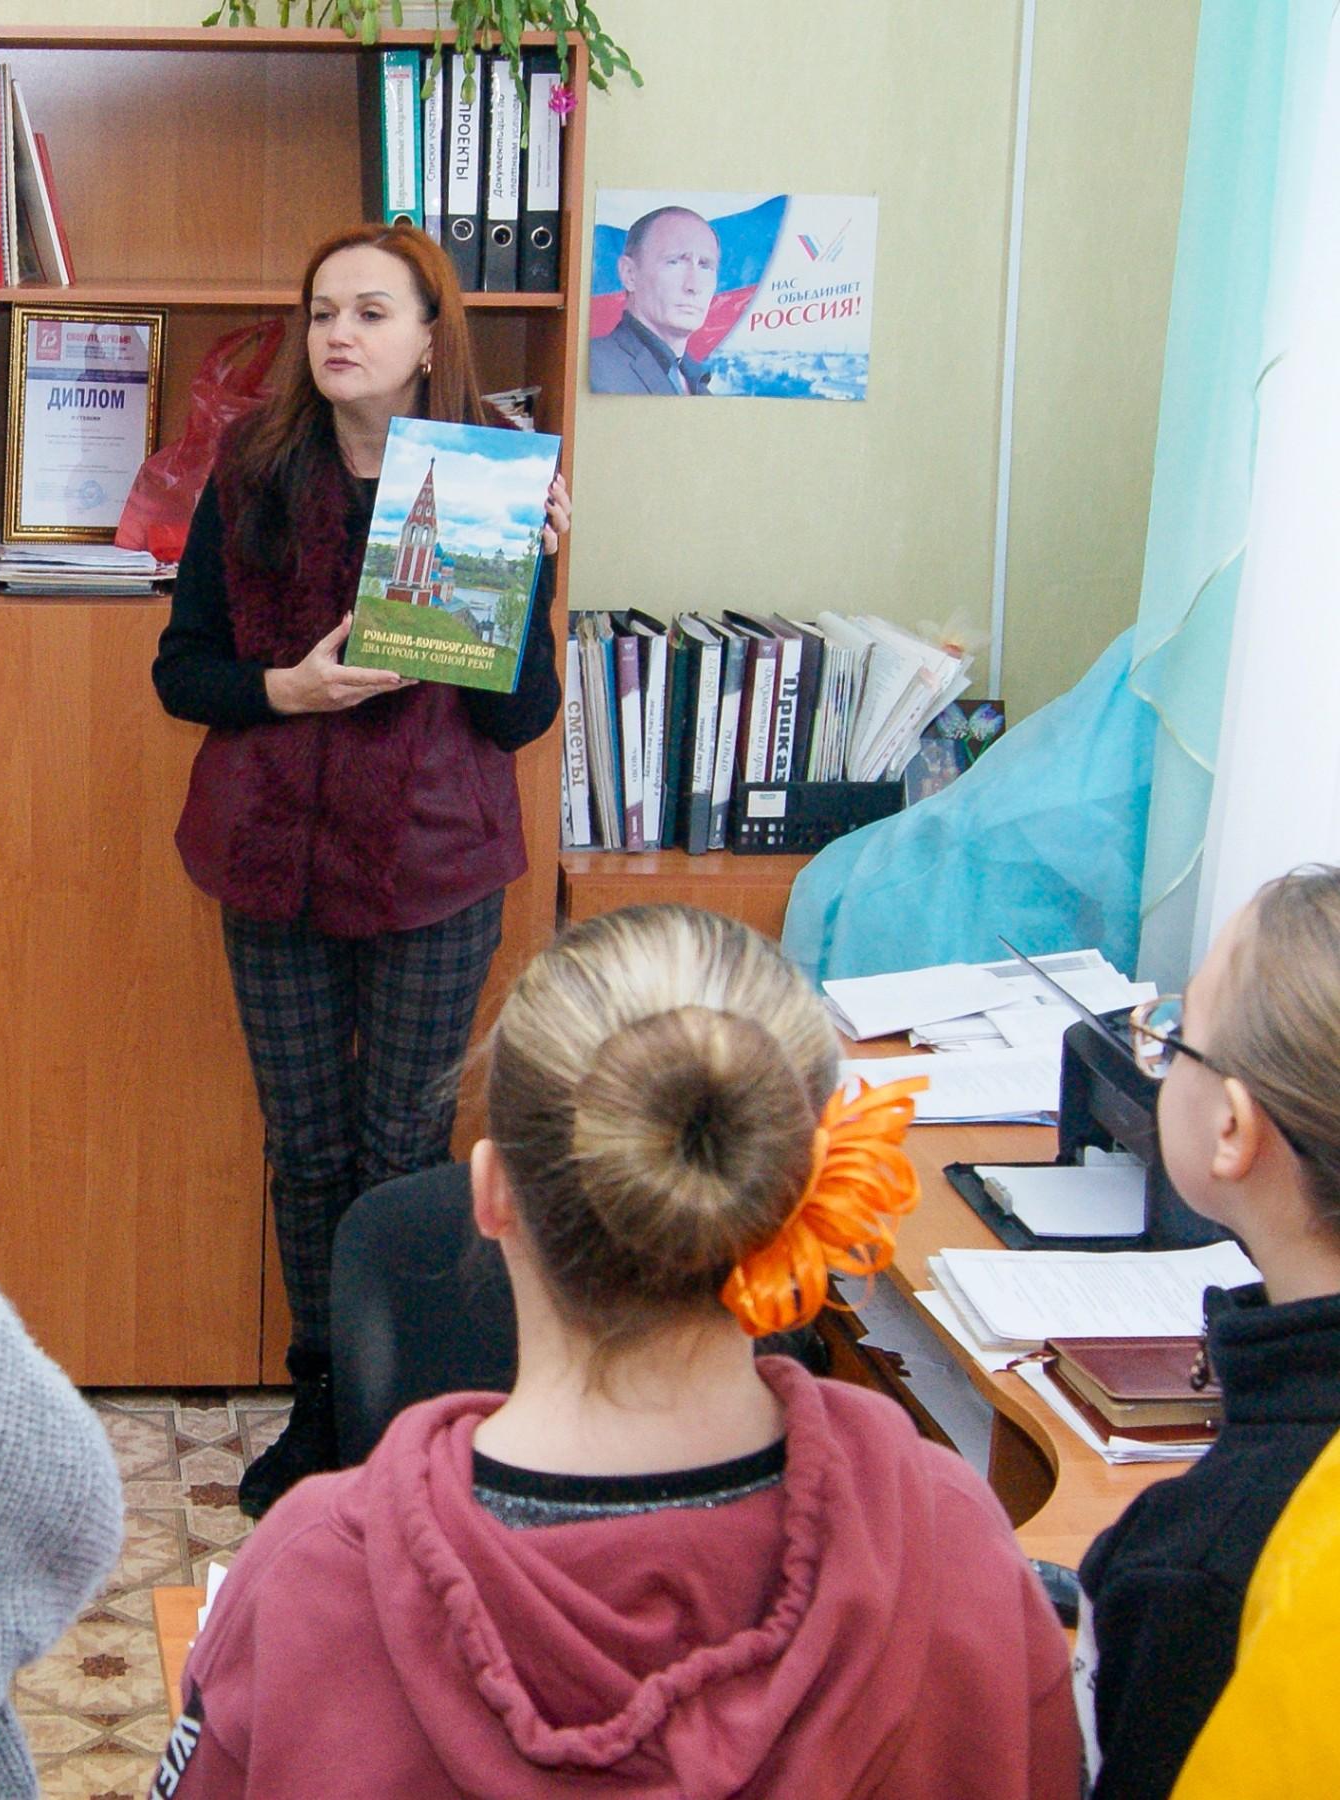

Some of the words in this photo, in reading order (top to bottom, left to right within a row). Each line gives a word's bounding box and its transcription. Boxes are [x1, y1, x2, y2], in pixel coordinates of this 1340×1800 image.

[456, 102, 472, 180] ПРОЕКТЫ
[426, 143, 437, 182] Списки
[771, 277, 798, 292] НАС
[777, 281, 861, 305] ОБЪЕДИНЯЕТ
[749, 296, 862, 332] РОССИЯ!
[47, 387, 126, 411] ДИПЛОМ
[361, 642, 380, 655] ДВА
[381, 645, 419, 660] ГОРОДА
[421, 650, 429, 661] У
[430, 652, 466, 667] ОДНОЙ
[467, 657, 493, 670] РЕКИ
[758, 667, 774, 732] Документы
[752, 752, 765, 782] орга
